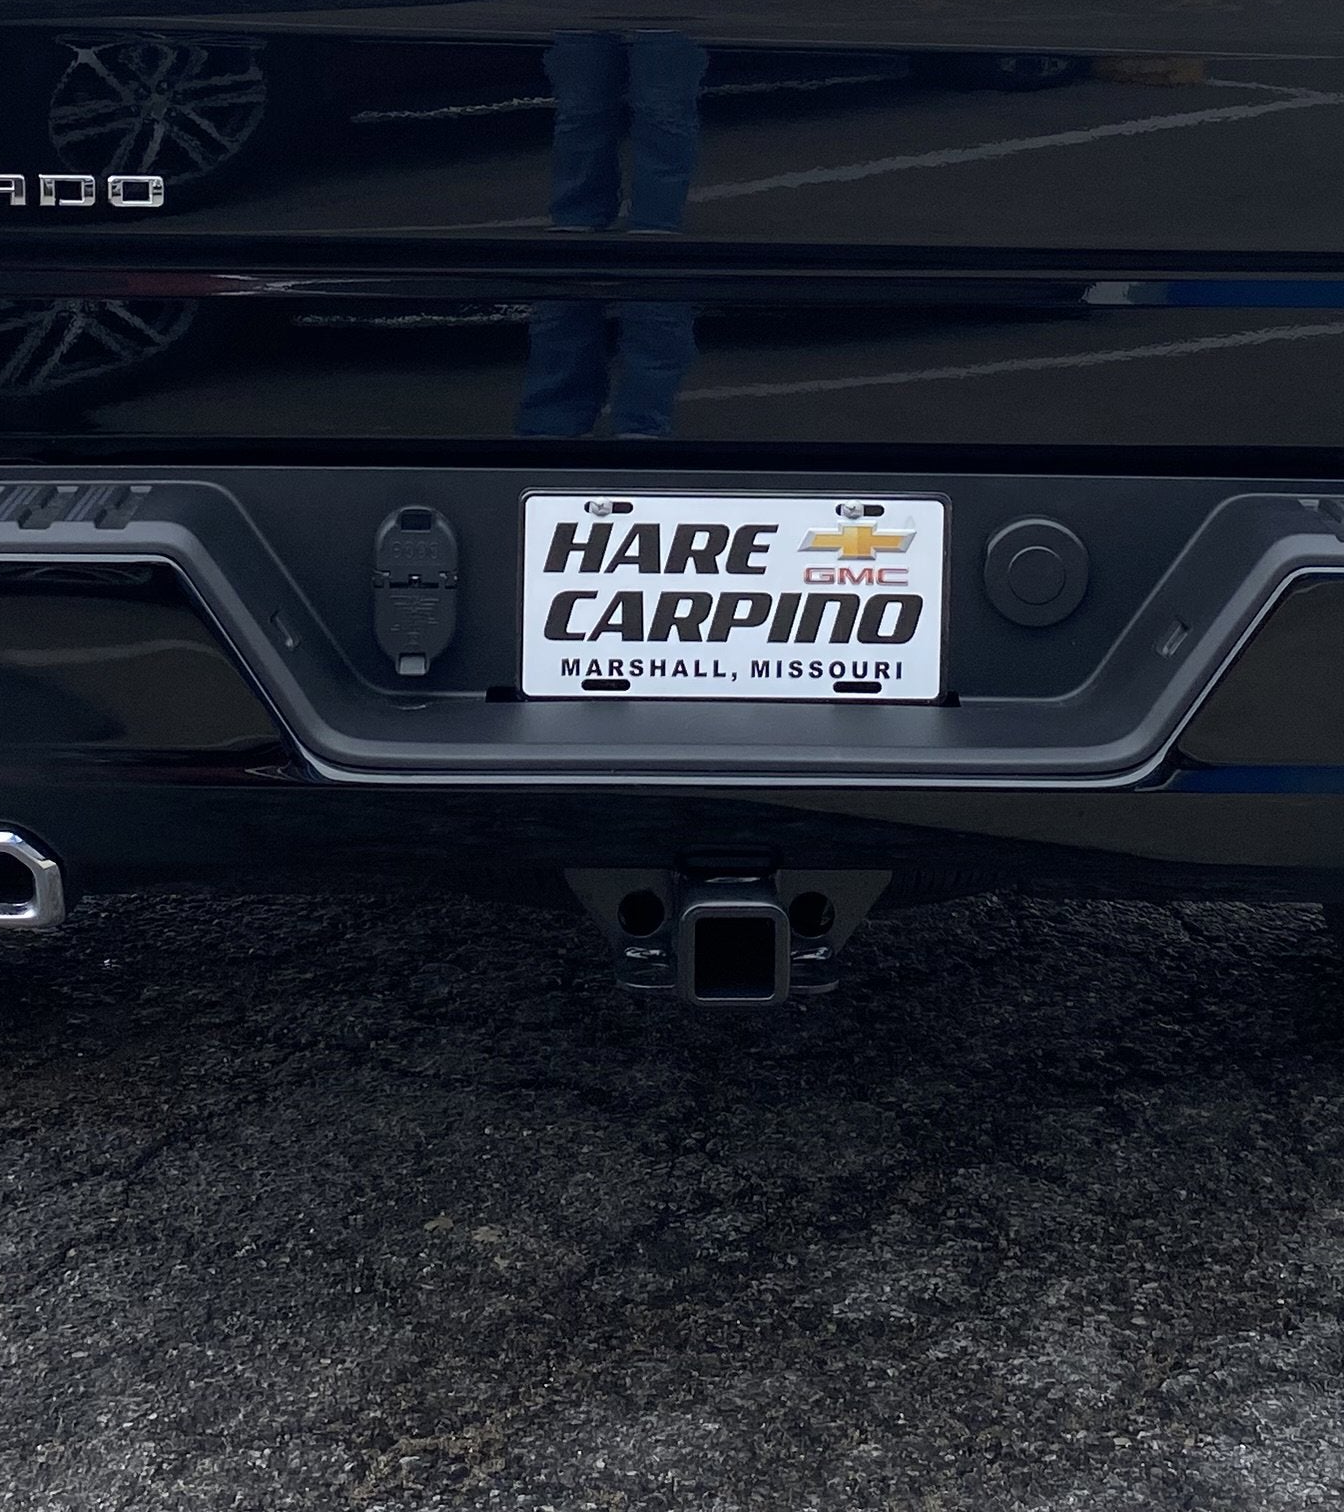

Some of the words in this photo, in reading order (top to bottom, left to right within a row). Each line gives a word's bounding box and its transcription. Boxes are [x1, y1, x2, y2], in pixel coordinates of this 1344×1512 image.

[543, 521, 779, 575] HARE
[803, 567, 910, 587] GMC
[544, 590, 925, 645] CARPINO
[560, 657, 739, 682] MARSHALL,
[750, 659, 904, 681] MISSOURI
